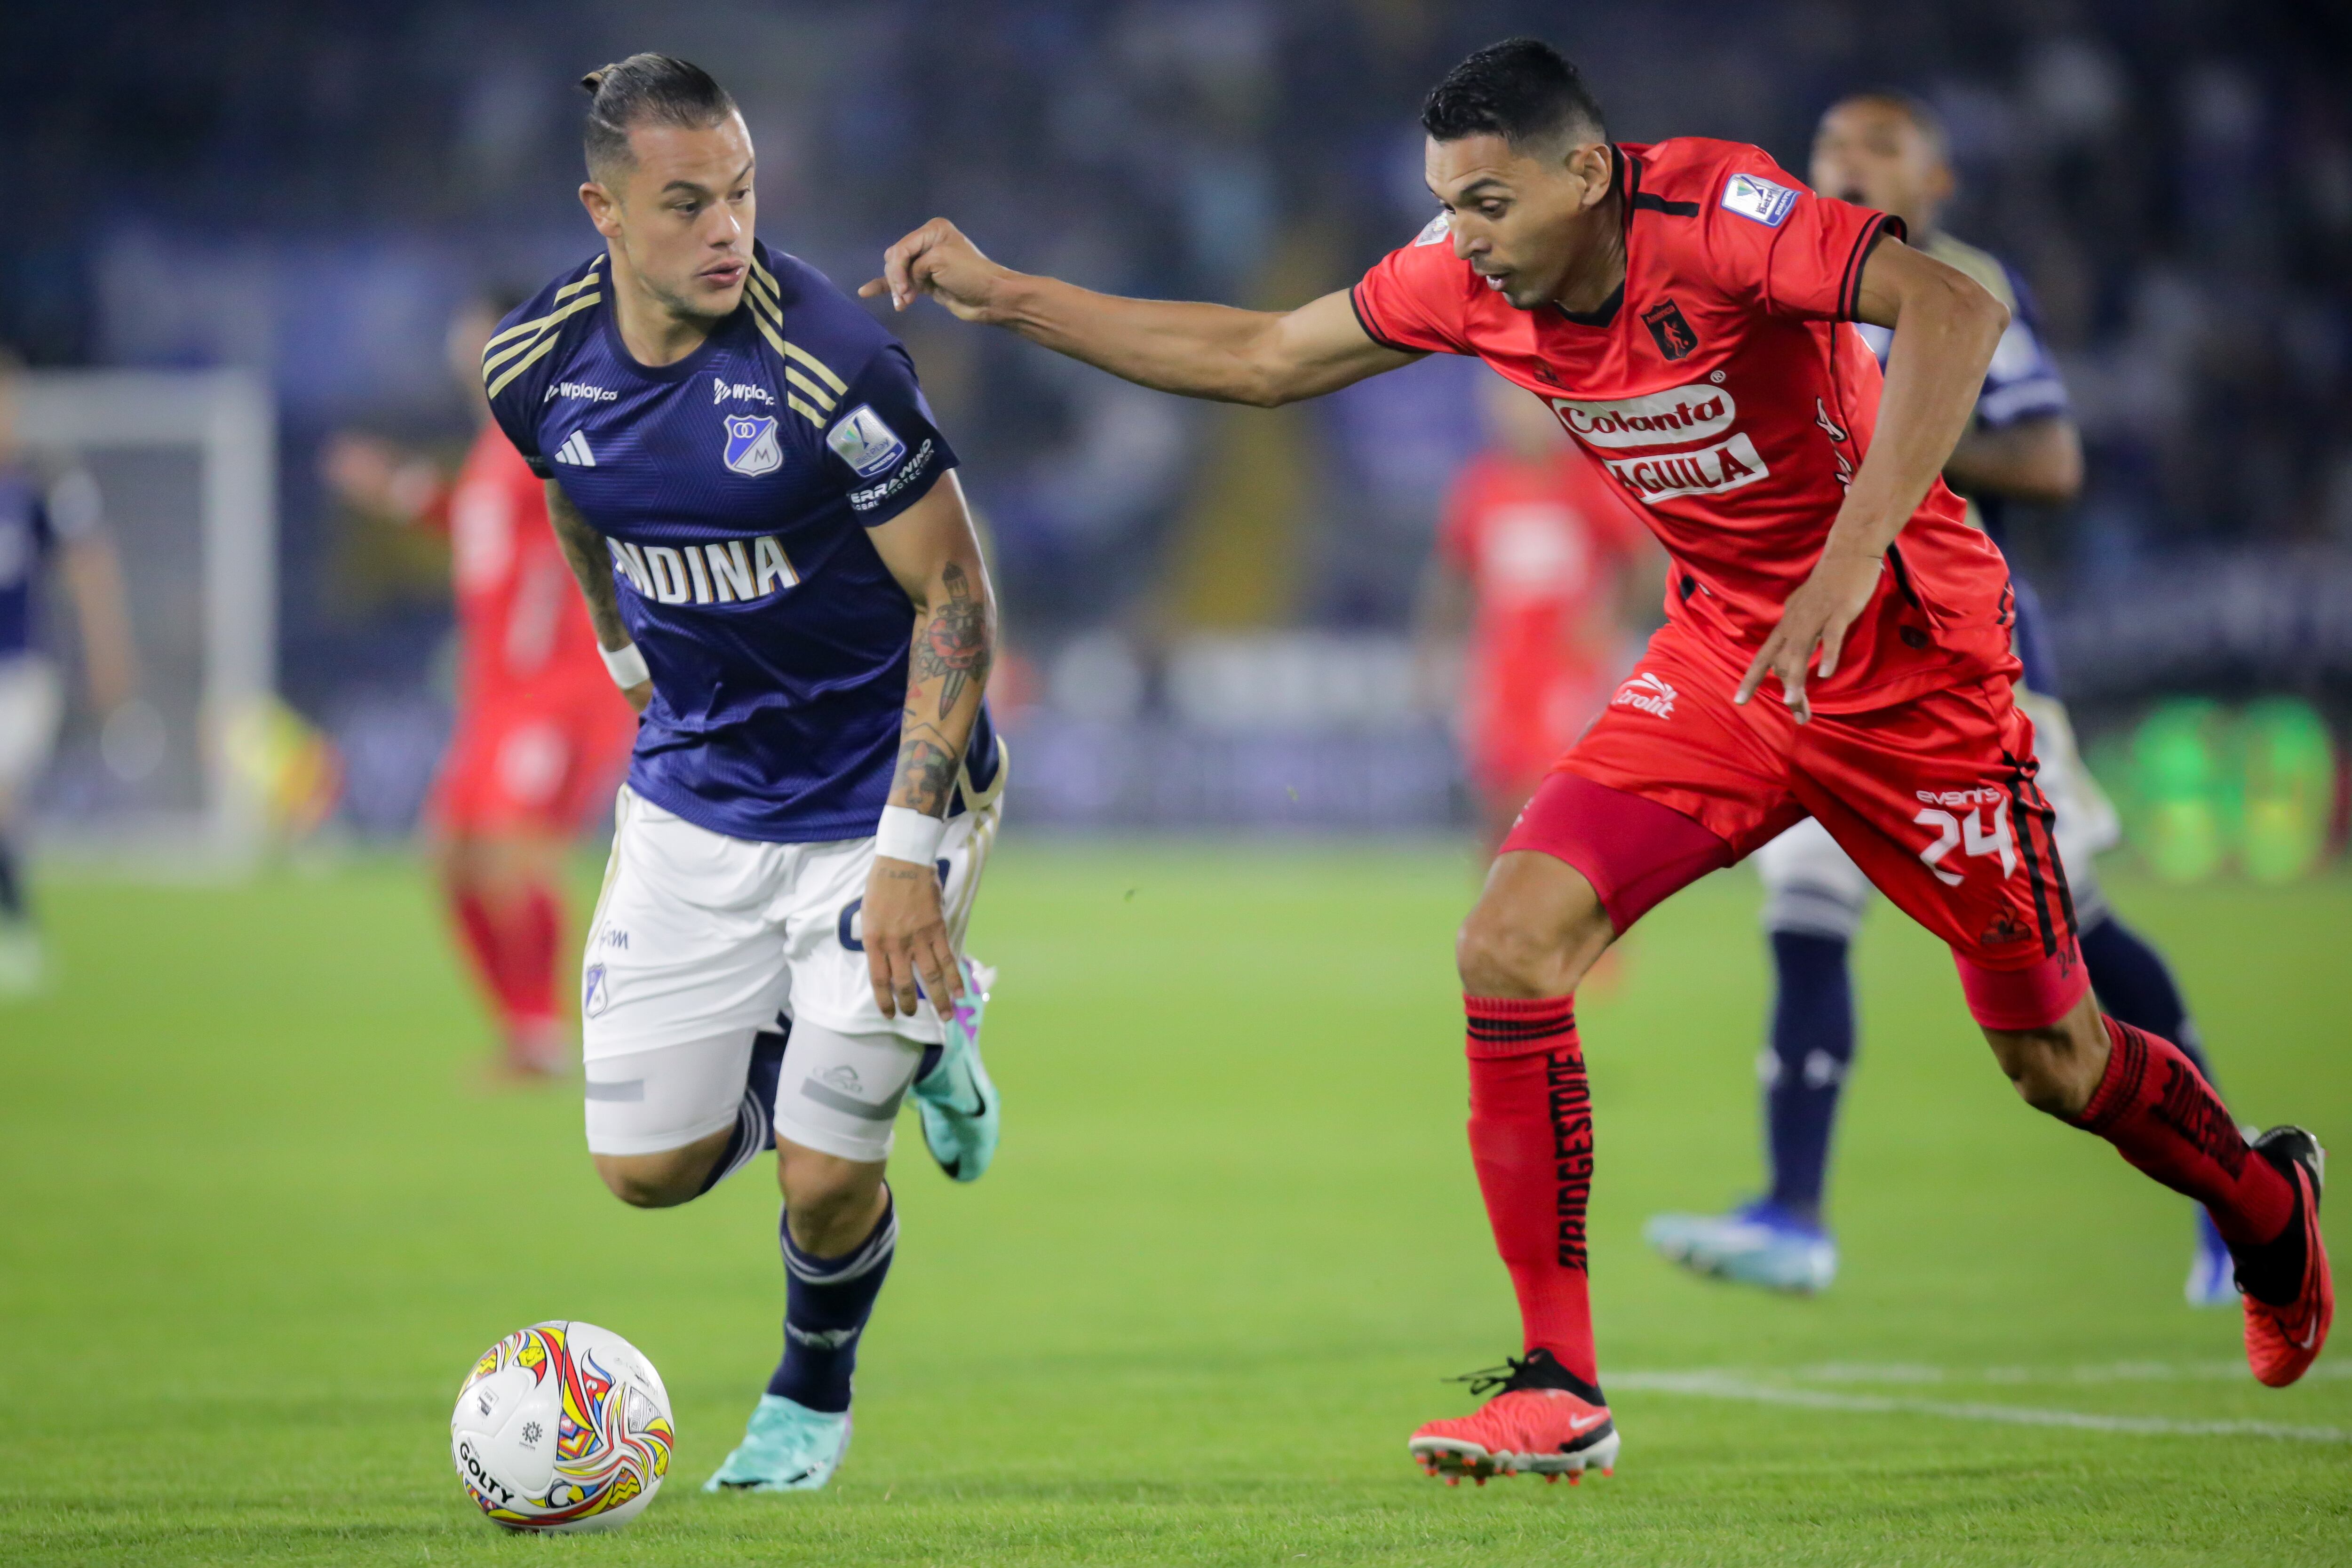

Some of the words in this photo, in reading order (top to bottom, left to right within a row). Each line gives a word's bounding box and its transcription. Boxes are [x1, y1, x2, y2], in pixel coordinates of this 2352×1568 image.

[1774, 190, 1794, 216] DIMAYO
[560, 382, 618, 403] Wplay.co
[1559, 395, 1725, 433] Colanta
[847, 438, 932, 504] ERRAWIND
[1612, 447, 1756, 499] AGUILA
[1913, 796, 2017, 887] 24
[460, 1441, 514, 1504] GOLTY
